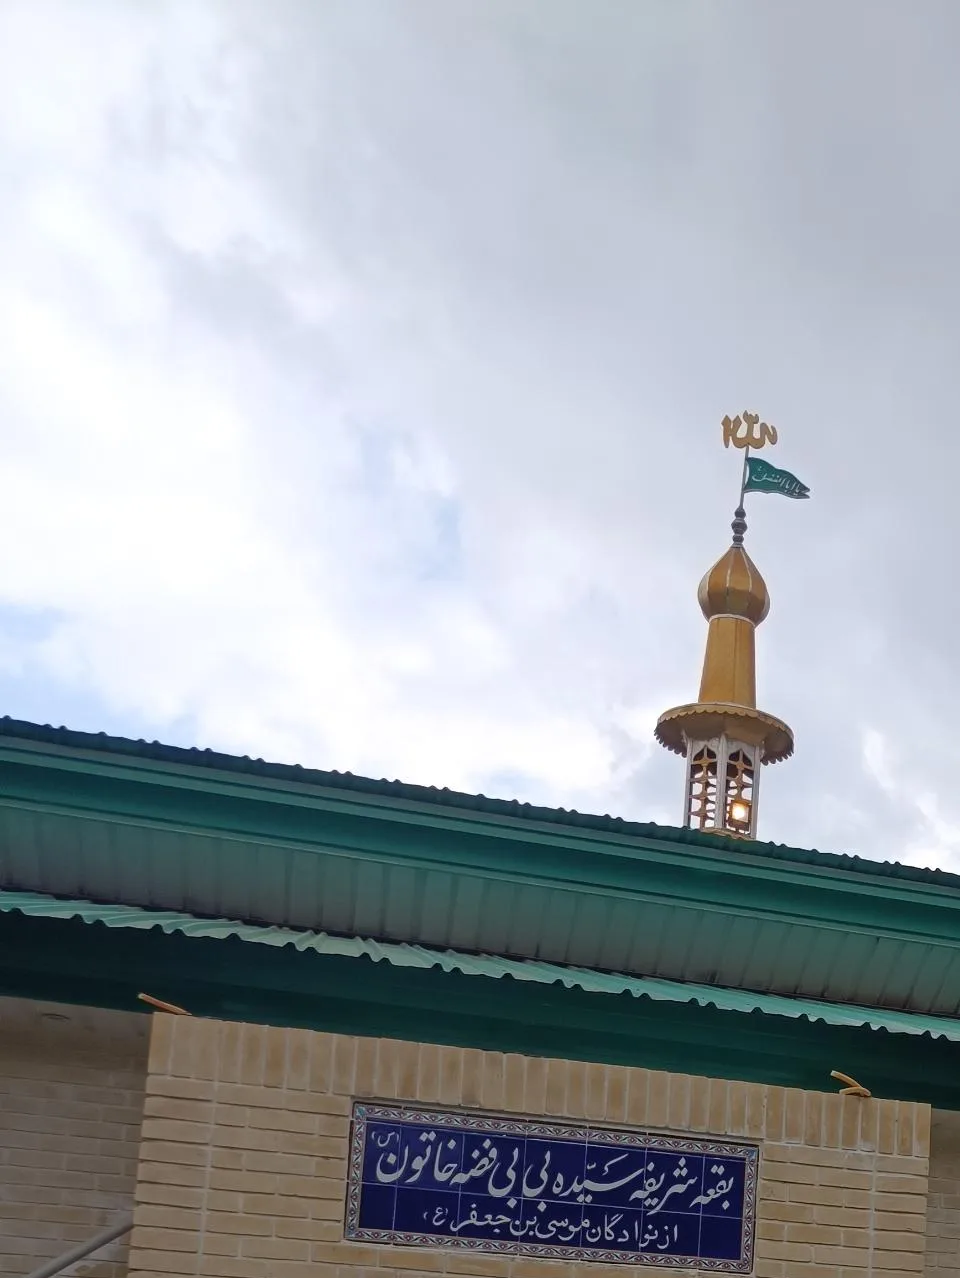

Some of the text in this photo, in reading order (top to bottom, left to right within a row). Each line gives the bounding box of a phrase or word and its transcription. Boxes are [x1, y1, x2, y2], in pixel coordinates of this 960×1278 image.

[375, 1130, 458, 1184] خاتون
[449, 1138, 498, 1186] فضه
[629, 1157, 698, 1216] شریفه
[689, 1164, 734, 1210] بقعه
[450, 1203, 512, 1233] جعفر
[509, 1215, 537, 1236] بن
[534, 1217, 591, 1242] موسی
[585, 1213, 659, 1248] نوادگان
[656, 1224, 678, 1250] از
